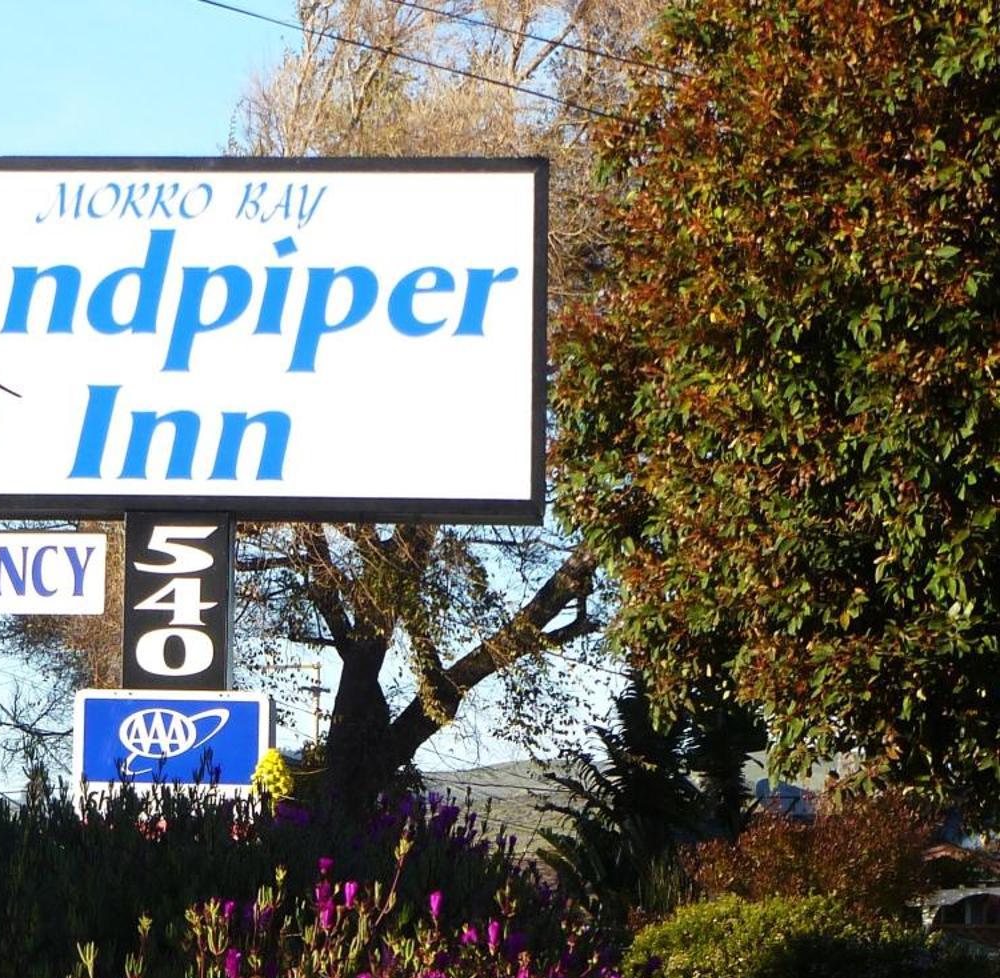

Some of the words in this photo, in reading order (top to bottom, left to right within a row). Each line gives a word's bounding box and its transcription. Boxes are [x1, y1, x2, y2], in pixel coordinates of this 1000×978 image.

[36, 182, 213, 223] MORRO
[235, 182, 327, 229] BAY
[68, 384, 292, 481] Inn
[133, 525, 218, 676] 540
[126, 711, 189, 755] AAA
